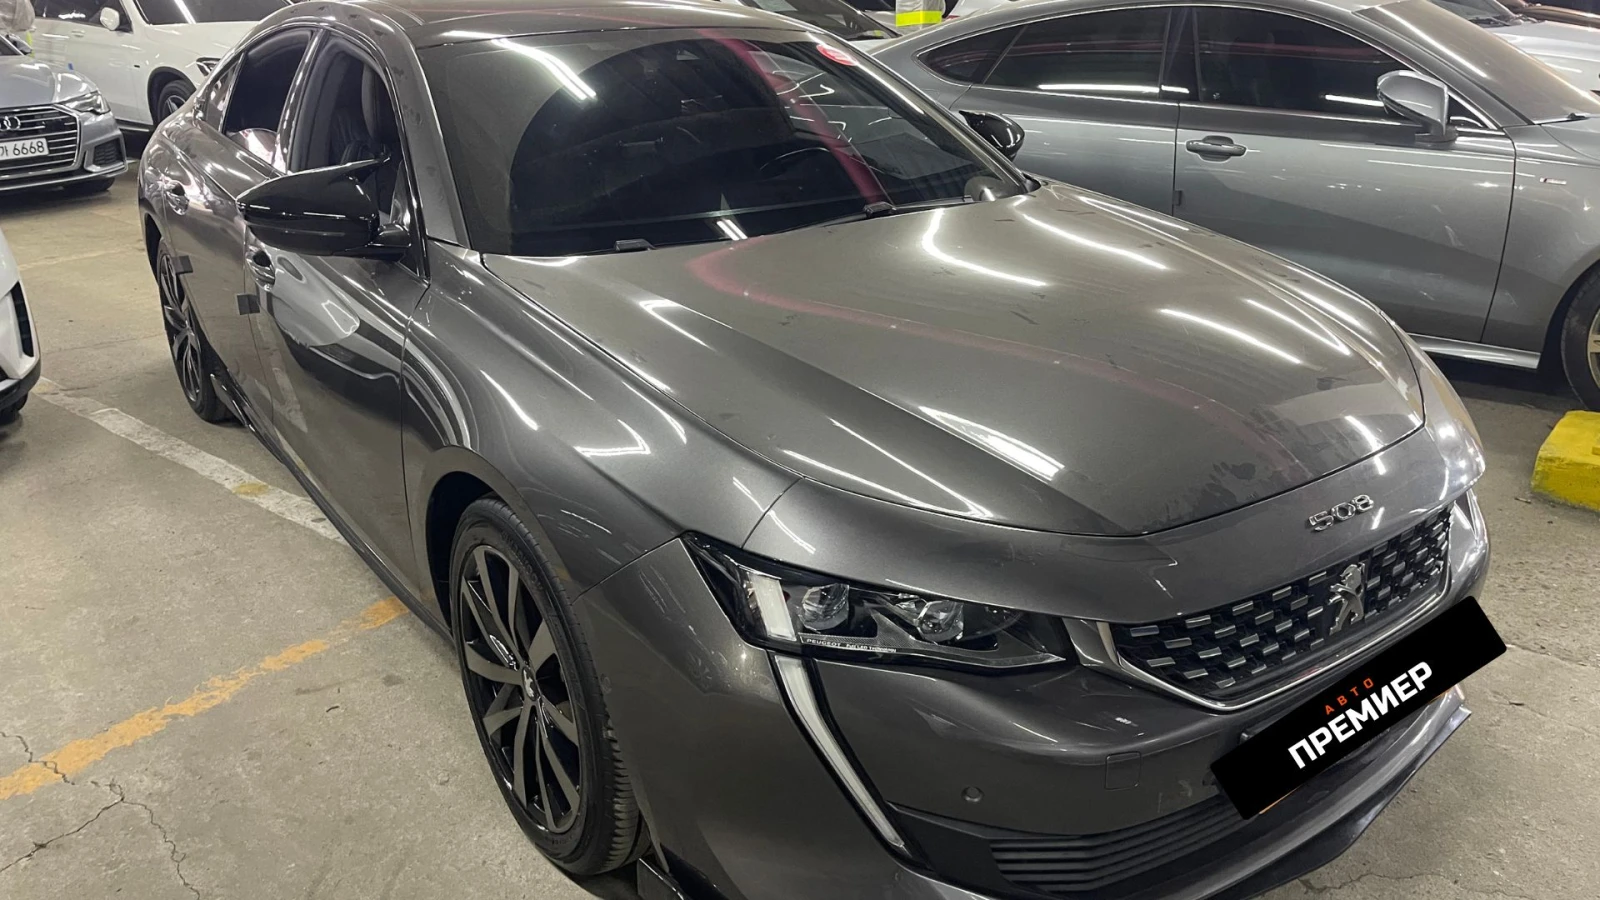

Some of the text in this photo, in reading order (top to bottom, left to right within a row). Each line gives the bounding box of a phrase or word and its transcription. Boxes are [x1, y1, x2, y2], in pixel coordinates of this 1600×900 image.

[13, 140, 45, 156] 6668
[1309, 494, 1374, 531] 508
[806, 638, 841, 647] PEUGEOT
